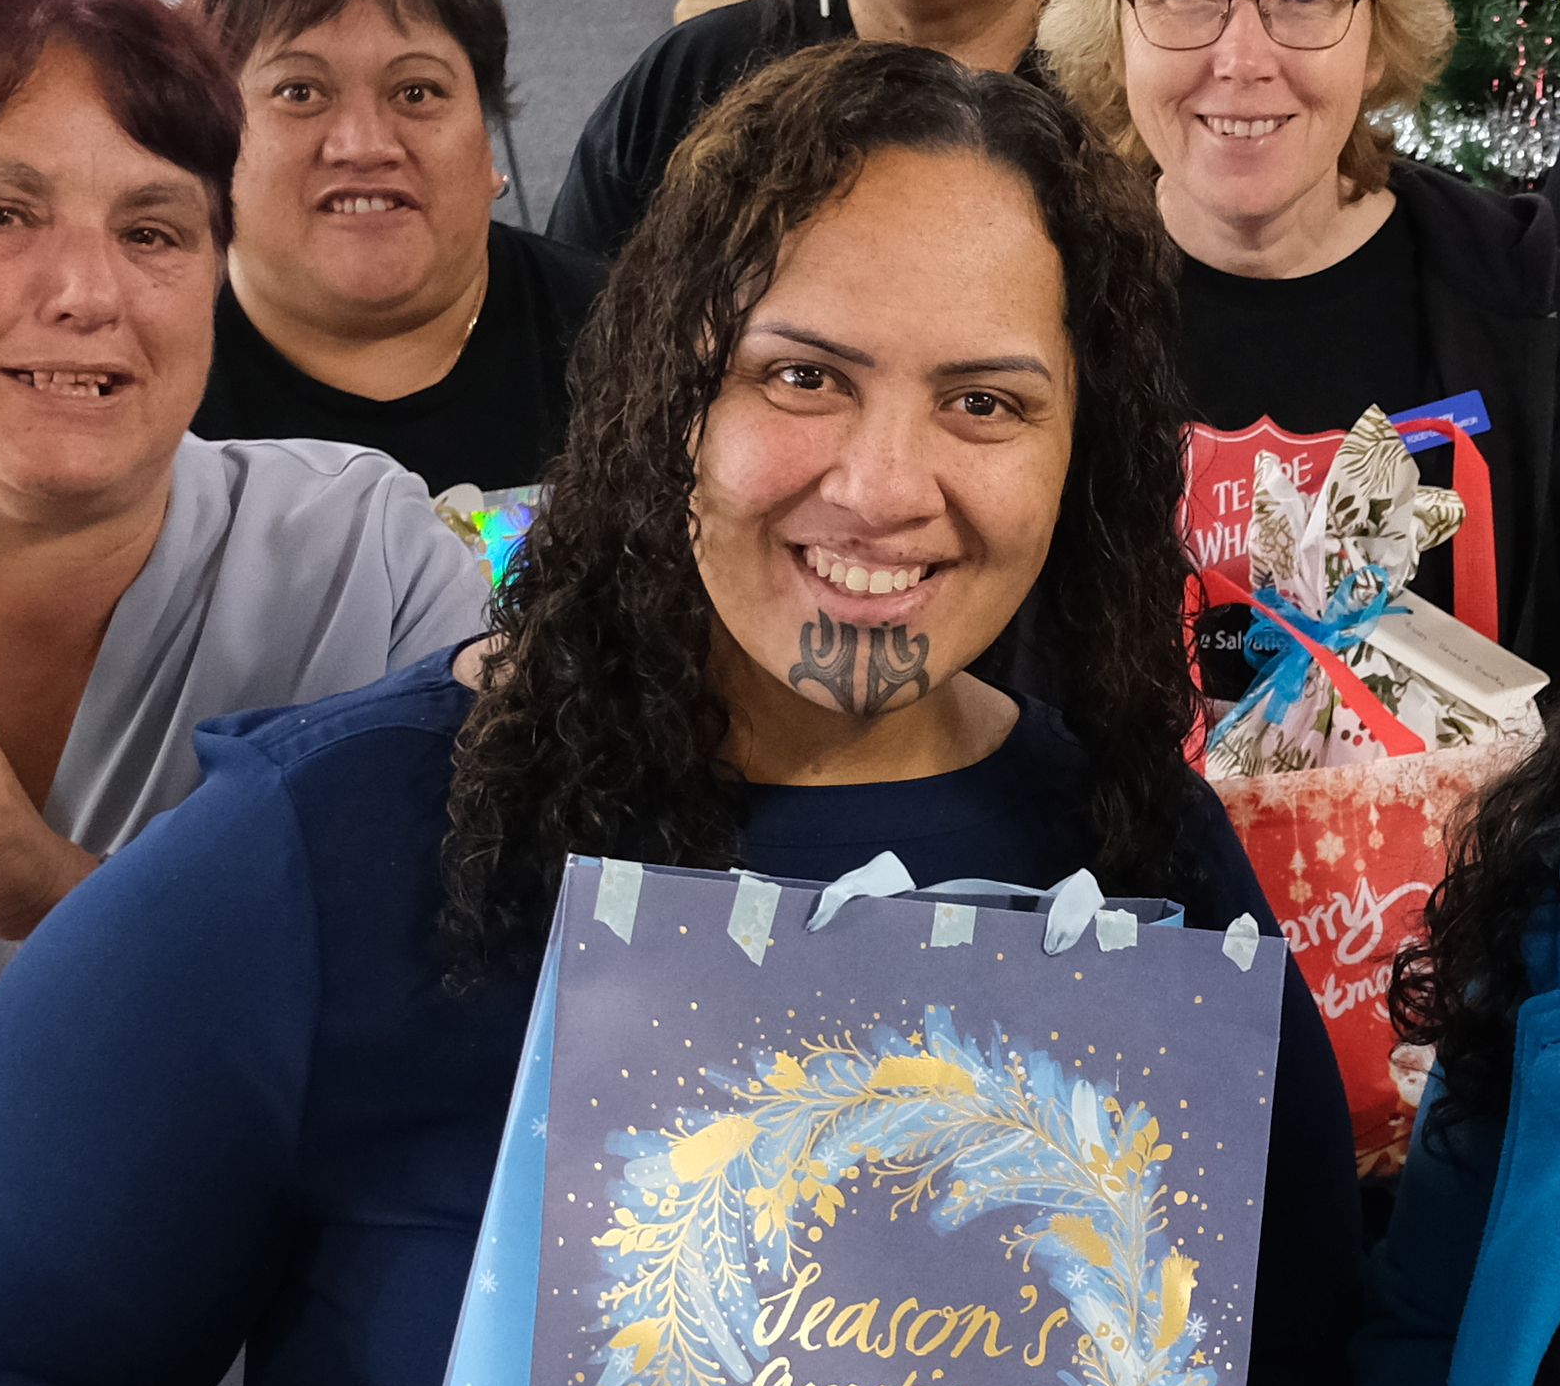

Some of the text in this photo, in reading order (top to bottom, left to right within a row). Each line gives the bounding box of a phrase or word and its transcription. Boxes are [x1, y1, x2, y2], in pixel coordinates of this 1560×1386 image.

[1212, 479, 1250, 516] TE
[1214, 629, 1289, 652] Salvatio
[1279, 876, 1434, 964] erry
[752, 1262, 1069, 1366] Season's
